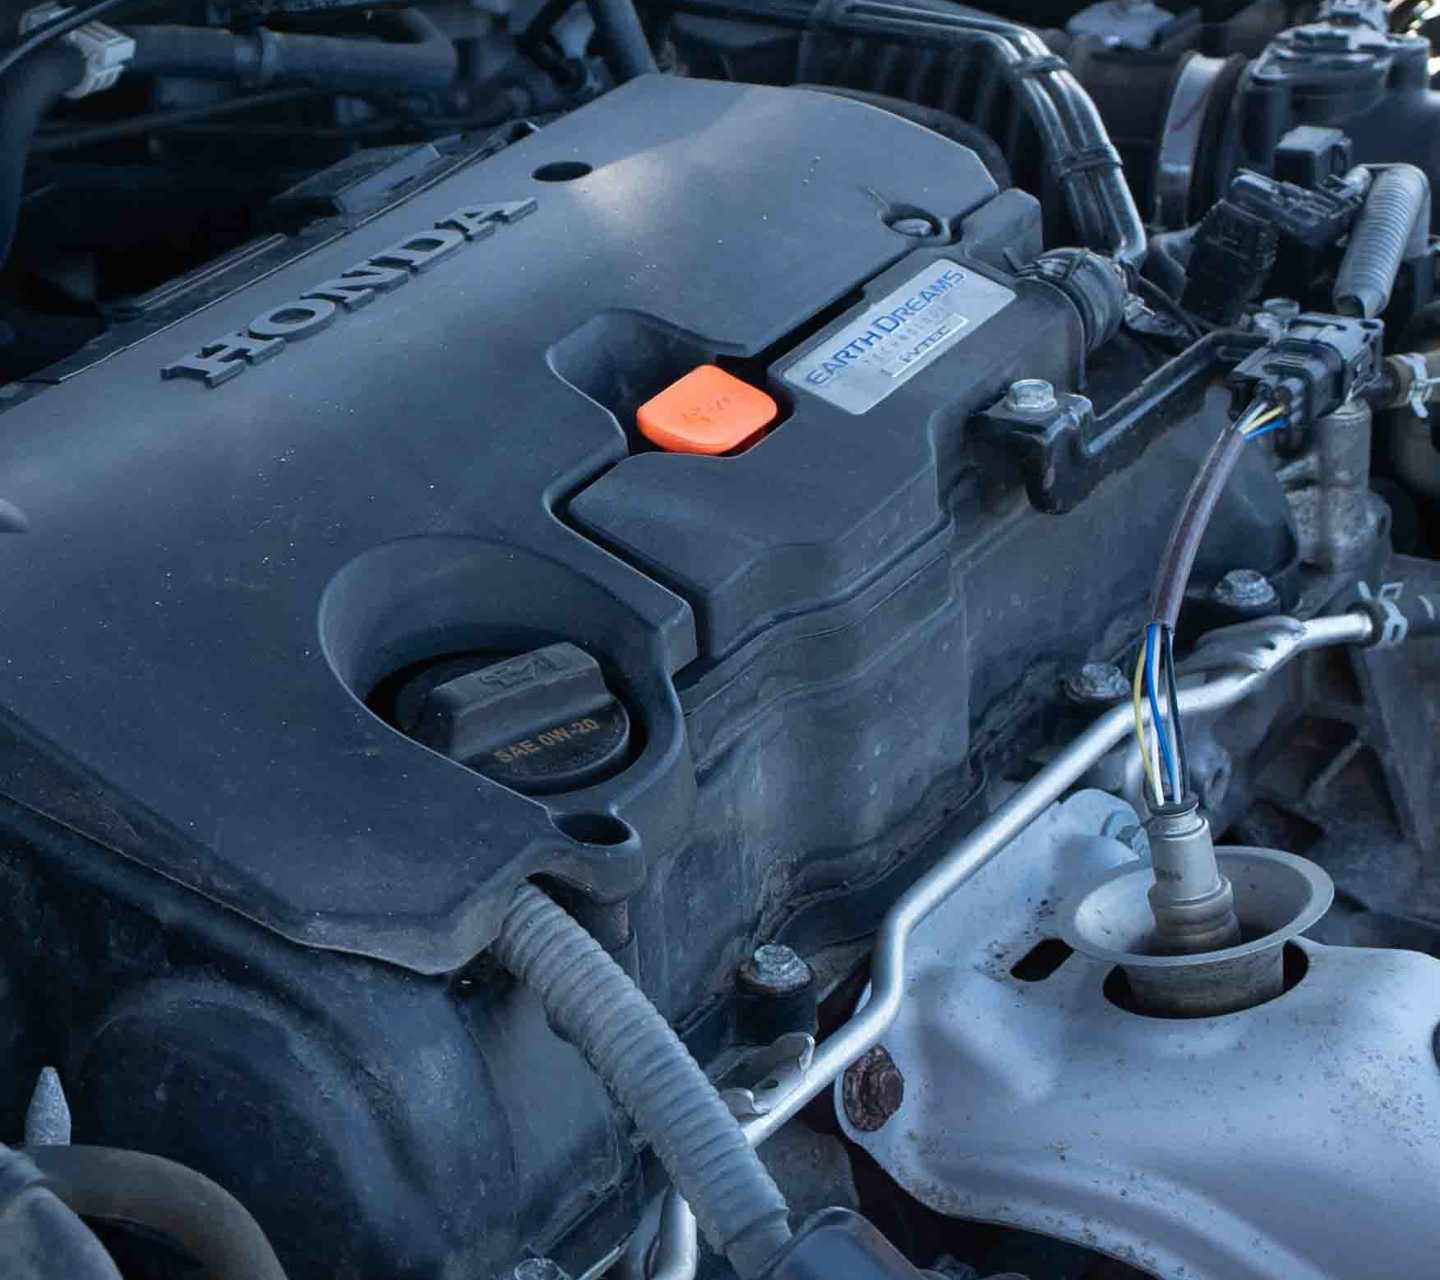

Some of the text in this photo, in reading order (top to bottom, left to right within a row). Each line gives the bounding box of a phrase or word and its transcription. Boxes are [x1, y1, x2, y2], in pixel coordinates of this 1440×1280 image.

[160, 197, 538, 389] HONDA
[805, 270, 965, 386] EARTH DREAMS
[493, 718, 601, 763] SAE 0W-20
